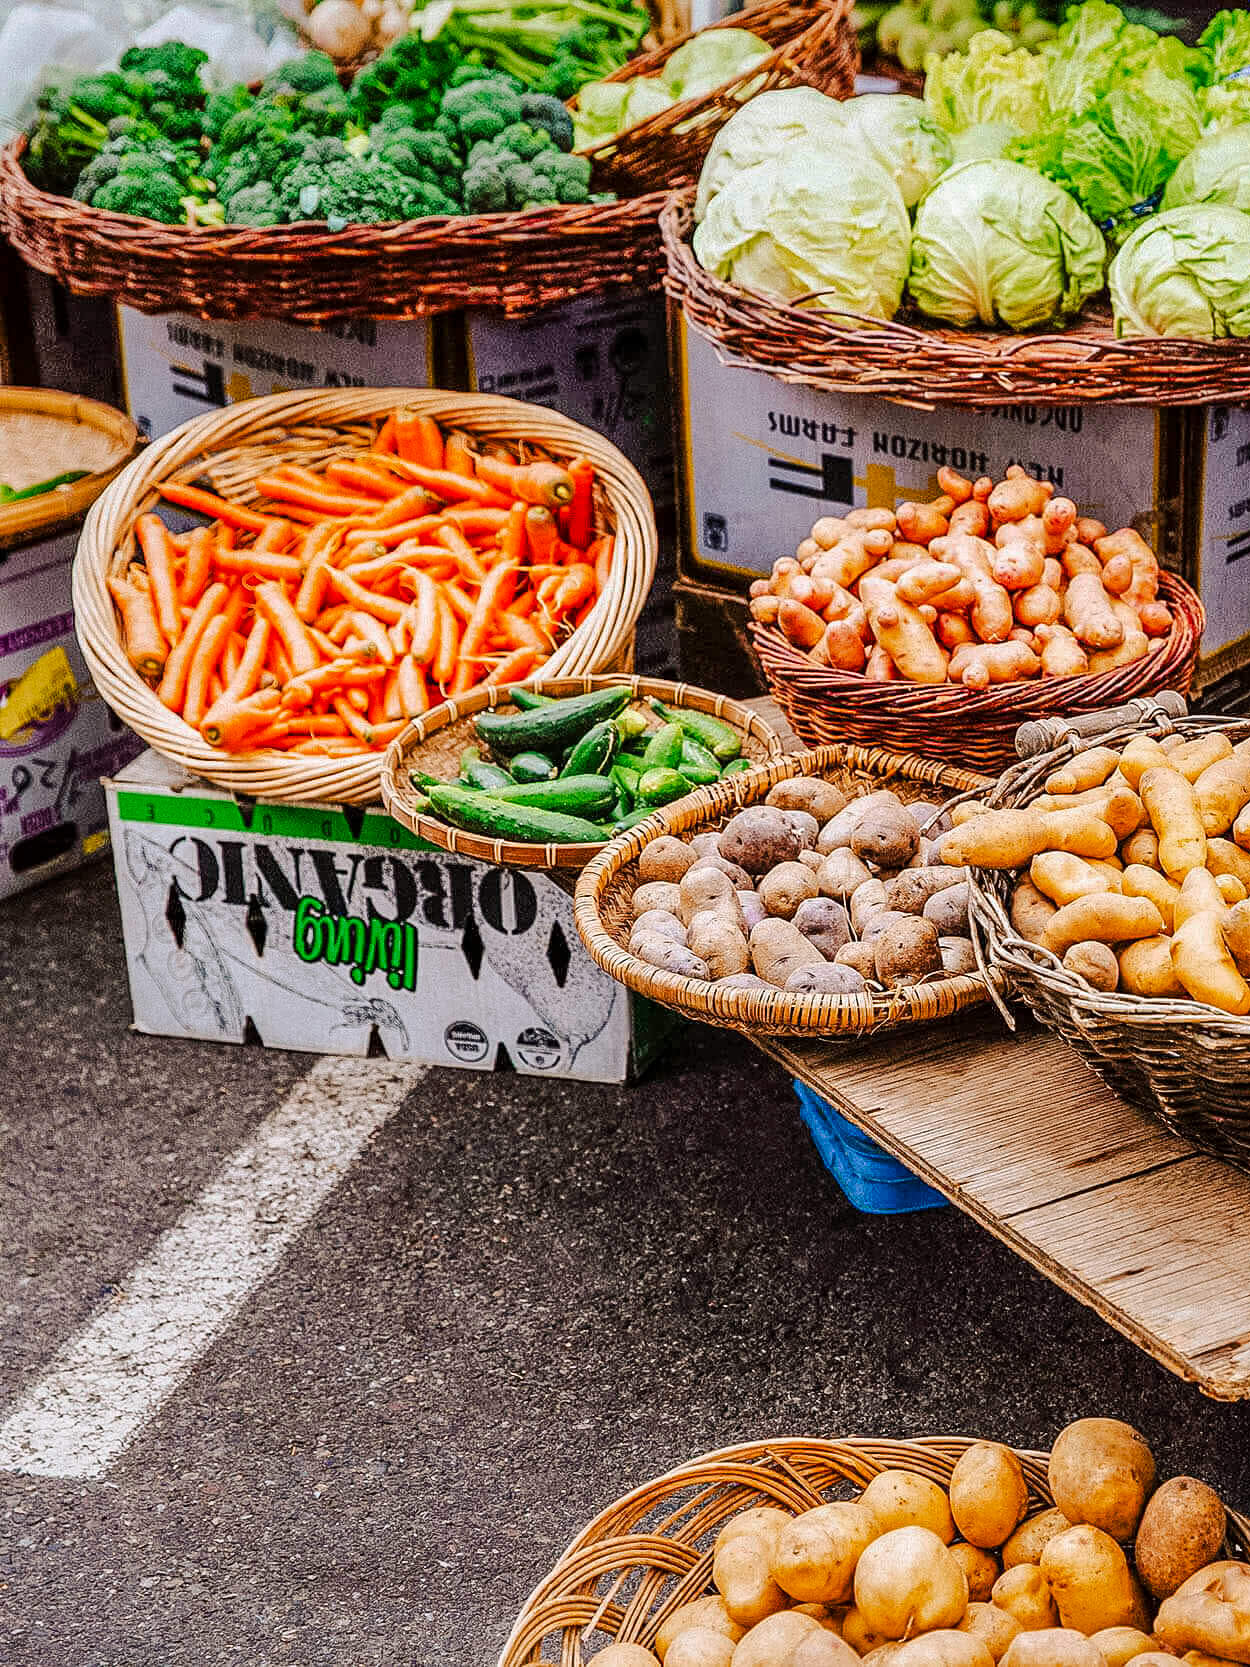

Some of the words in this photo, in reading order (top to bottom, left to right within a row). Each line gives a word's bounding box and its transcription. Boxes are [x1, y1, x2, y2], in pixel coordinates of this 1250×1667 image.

[767, 411, 858, 448] FARMS
[872, 432, 987, 474] HORIZON
[168, 836, 538, 936] ORGANIC
[293, 896, 418, 994] living
